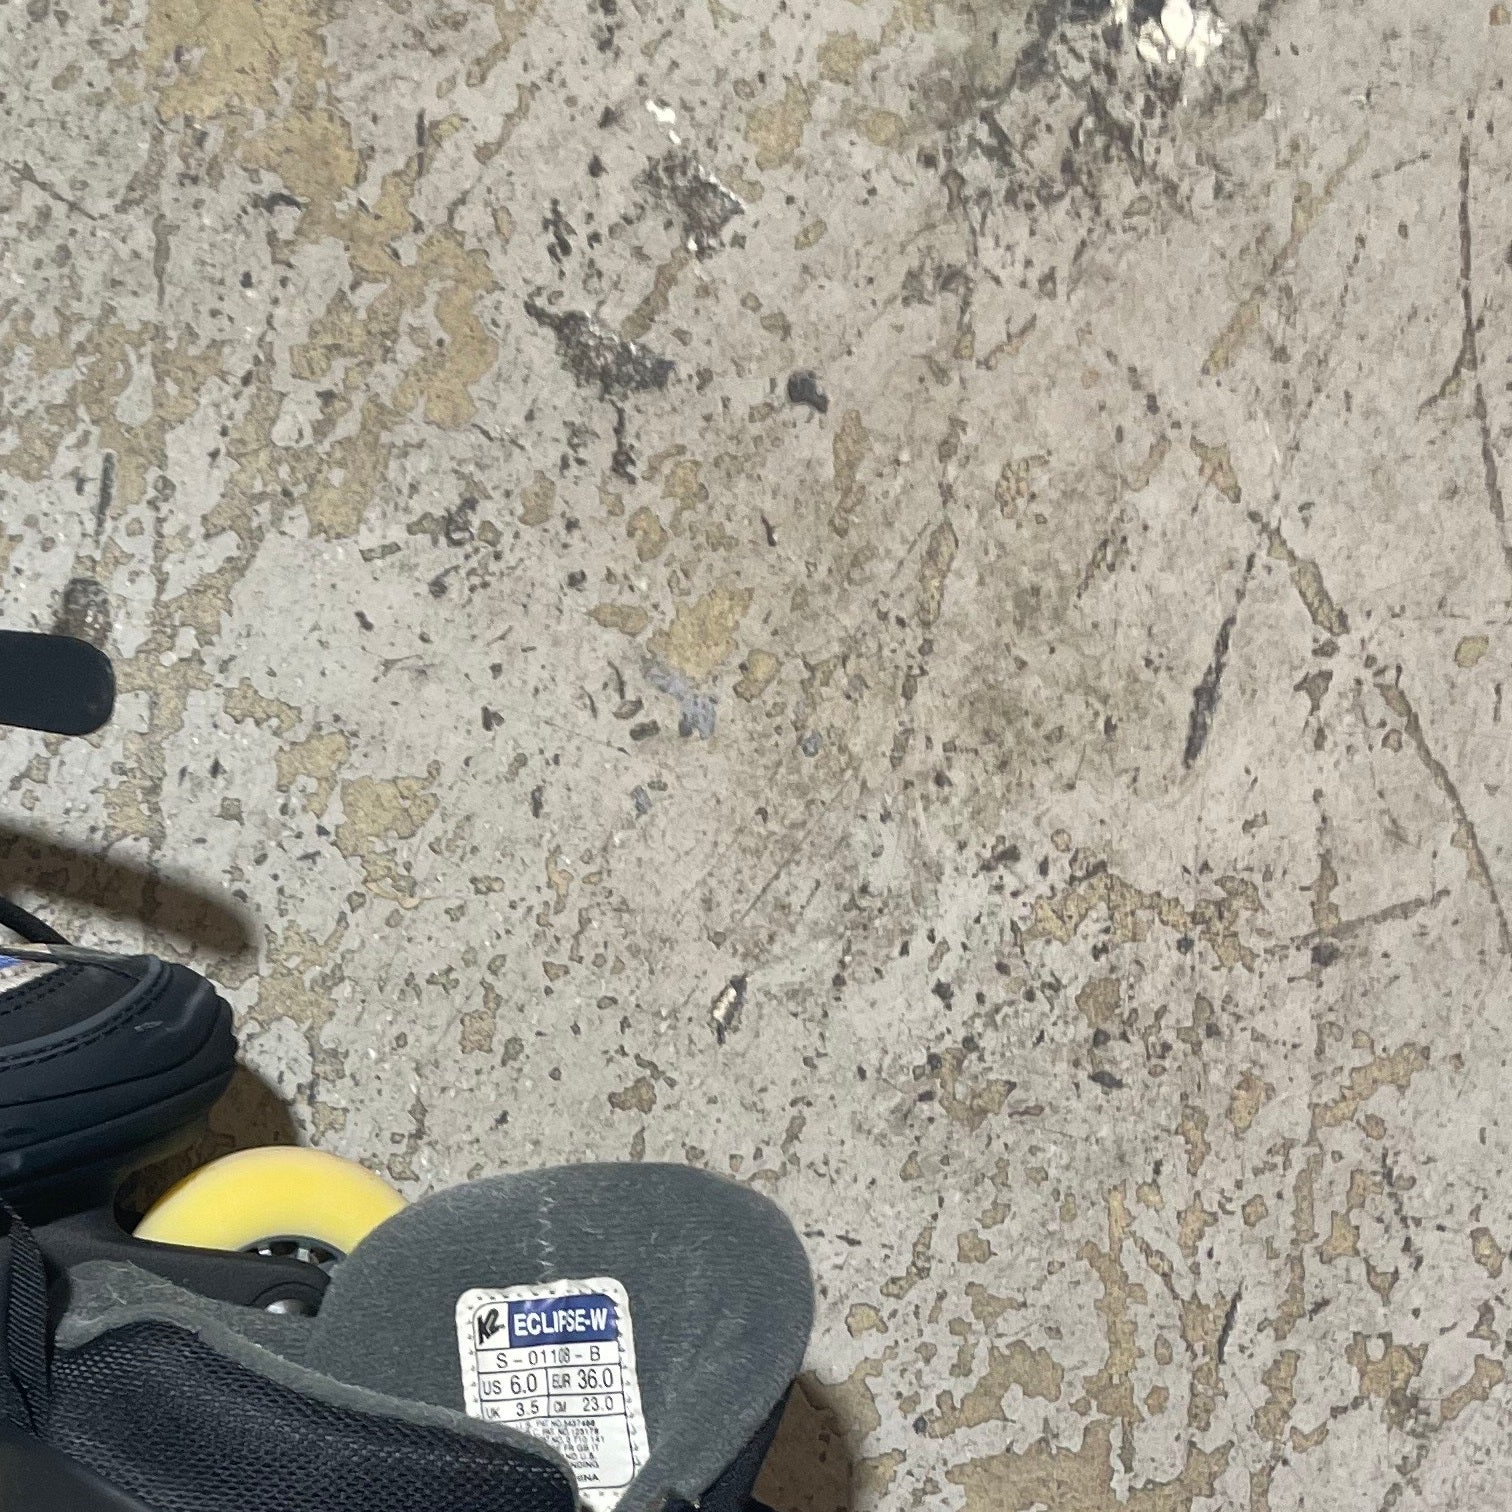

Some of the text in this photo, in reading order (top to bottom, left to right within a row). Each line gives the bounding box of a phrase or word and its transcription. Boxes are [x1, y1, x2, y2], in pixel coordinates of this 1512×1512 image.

[477, 1307, 608, 1345] K2 ECLIPSE-W
[482, 1380, 502, 1395] US
[510, 1373, 537, 1395] 6.0
[577, 1367, 613, 1390] 36.0
[516, 1400, 539, 1417] 3.5
[582, 1395, 614, 1413] 23.0
